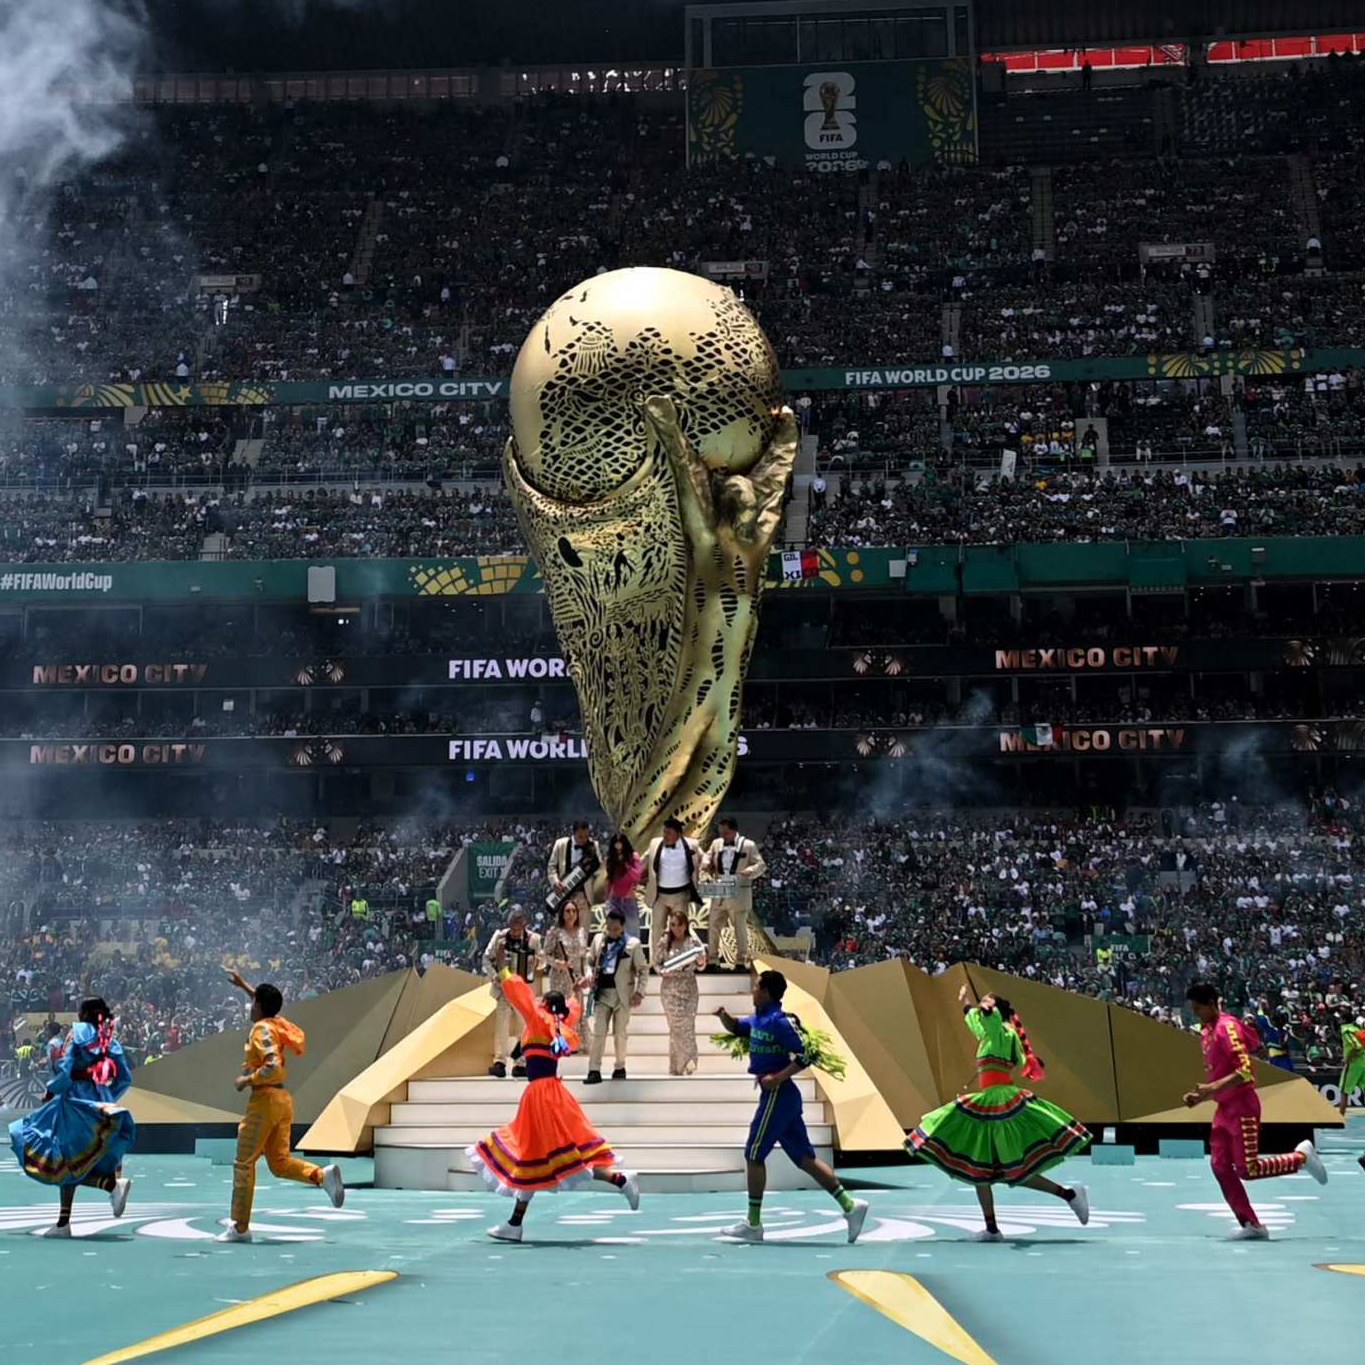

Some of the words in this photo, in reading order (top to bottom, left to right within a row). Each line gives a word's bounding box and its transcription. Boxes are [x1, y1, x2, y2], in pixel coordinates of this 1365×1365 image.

[819, 134, 843, 143] FIFA
[805, 152, 838, 161] WORLD
[839, 151, 859, 159] CUP
[845, 371, 882, 385] FIFA
[885, 369, 948, 384] WORLD
[951, 367, 986, 381] CUP
[989, 364, 1051, 380] 2026
[329, 382, 433, 399] MEXICO
[439, 381, 503, 396] CITY
[0, 572, 112, 592] #FIFAWorldCup
[995, 647, 1106, 669] MEXICO
[1113, 646, 1180, 667] CITY
[33, 664, 138, 684] MEXICO
[145, 664, 207, 684] CITY
[448, 659, 502, 679] FIFA
[506, 658, 572, 678] WOR
[448, 739, 503, 760] FIFA
[506, 738, 588, 759] WORL
[999, 730, 1111, 752] MICO
[1118, 729, 1186, 750] CITY
[30, 744, 135, 764] MEXICO
[142, 744, 205, 764] CITY
[476, 855, 507, 867] SALIDA
[479, 867, 498, 879] EXIT
